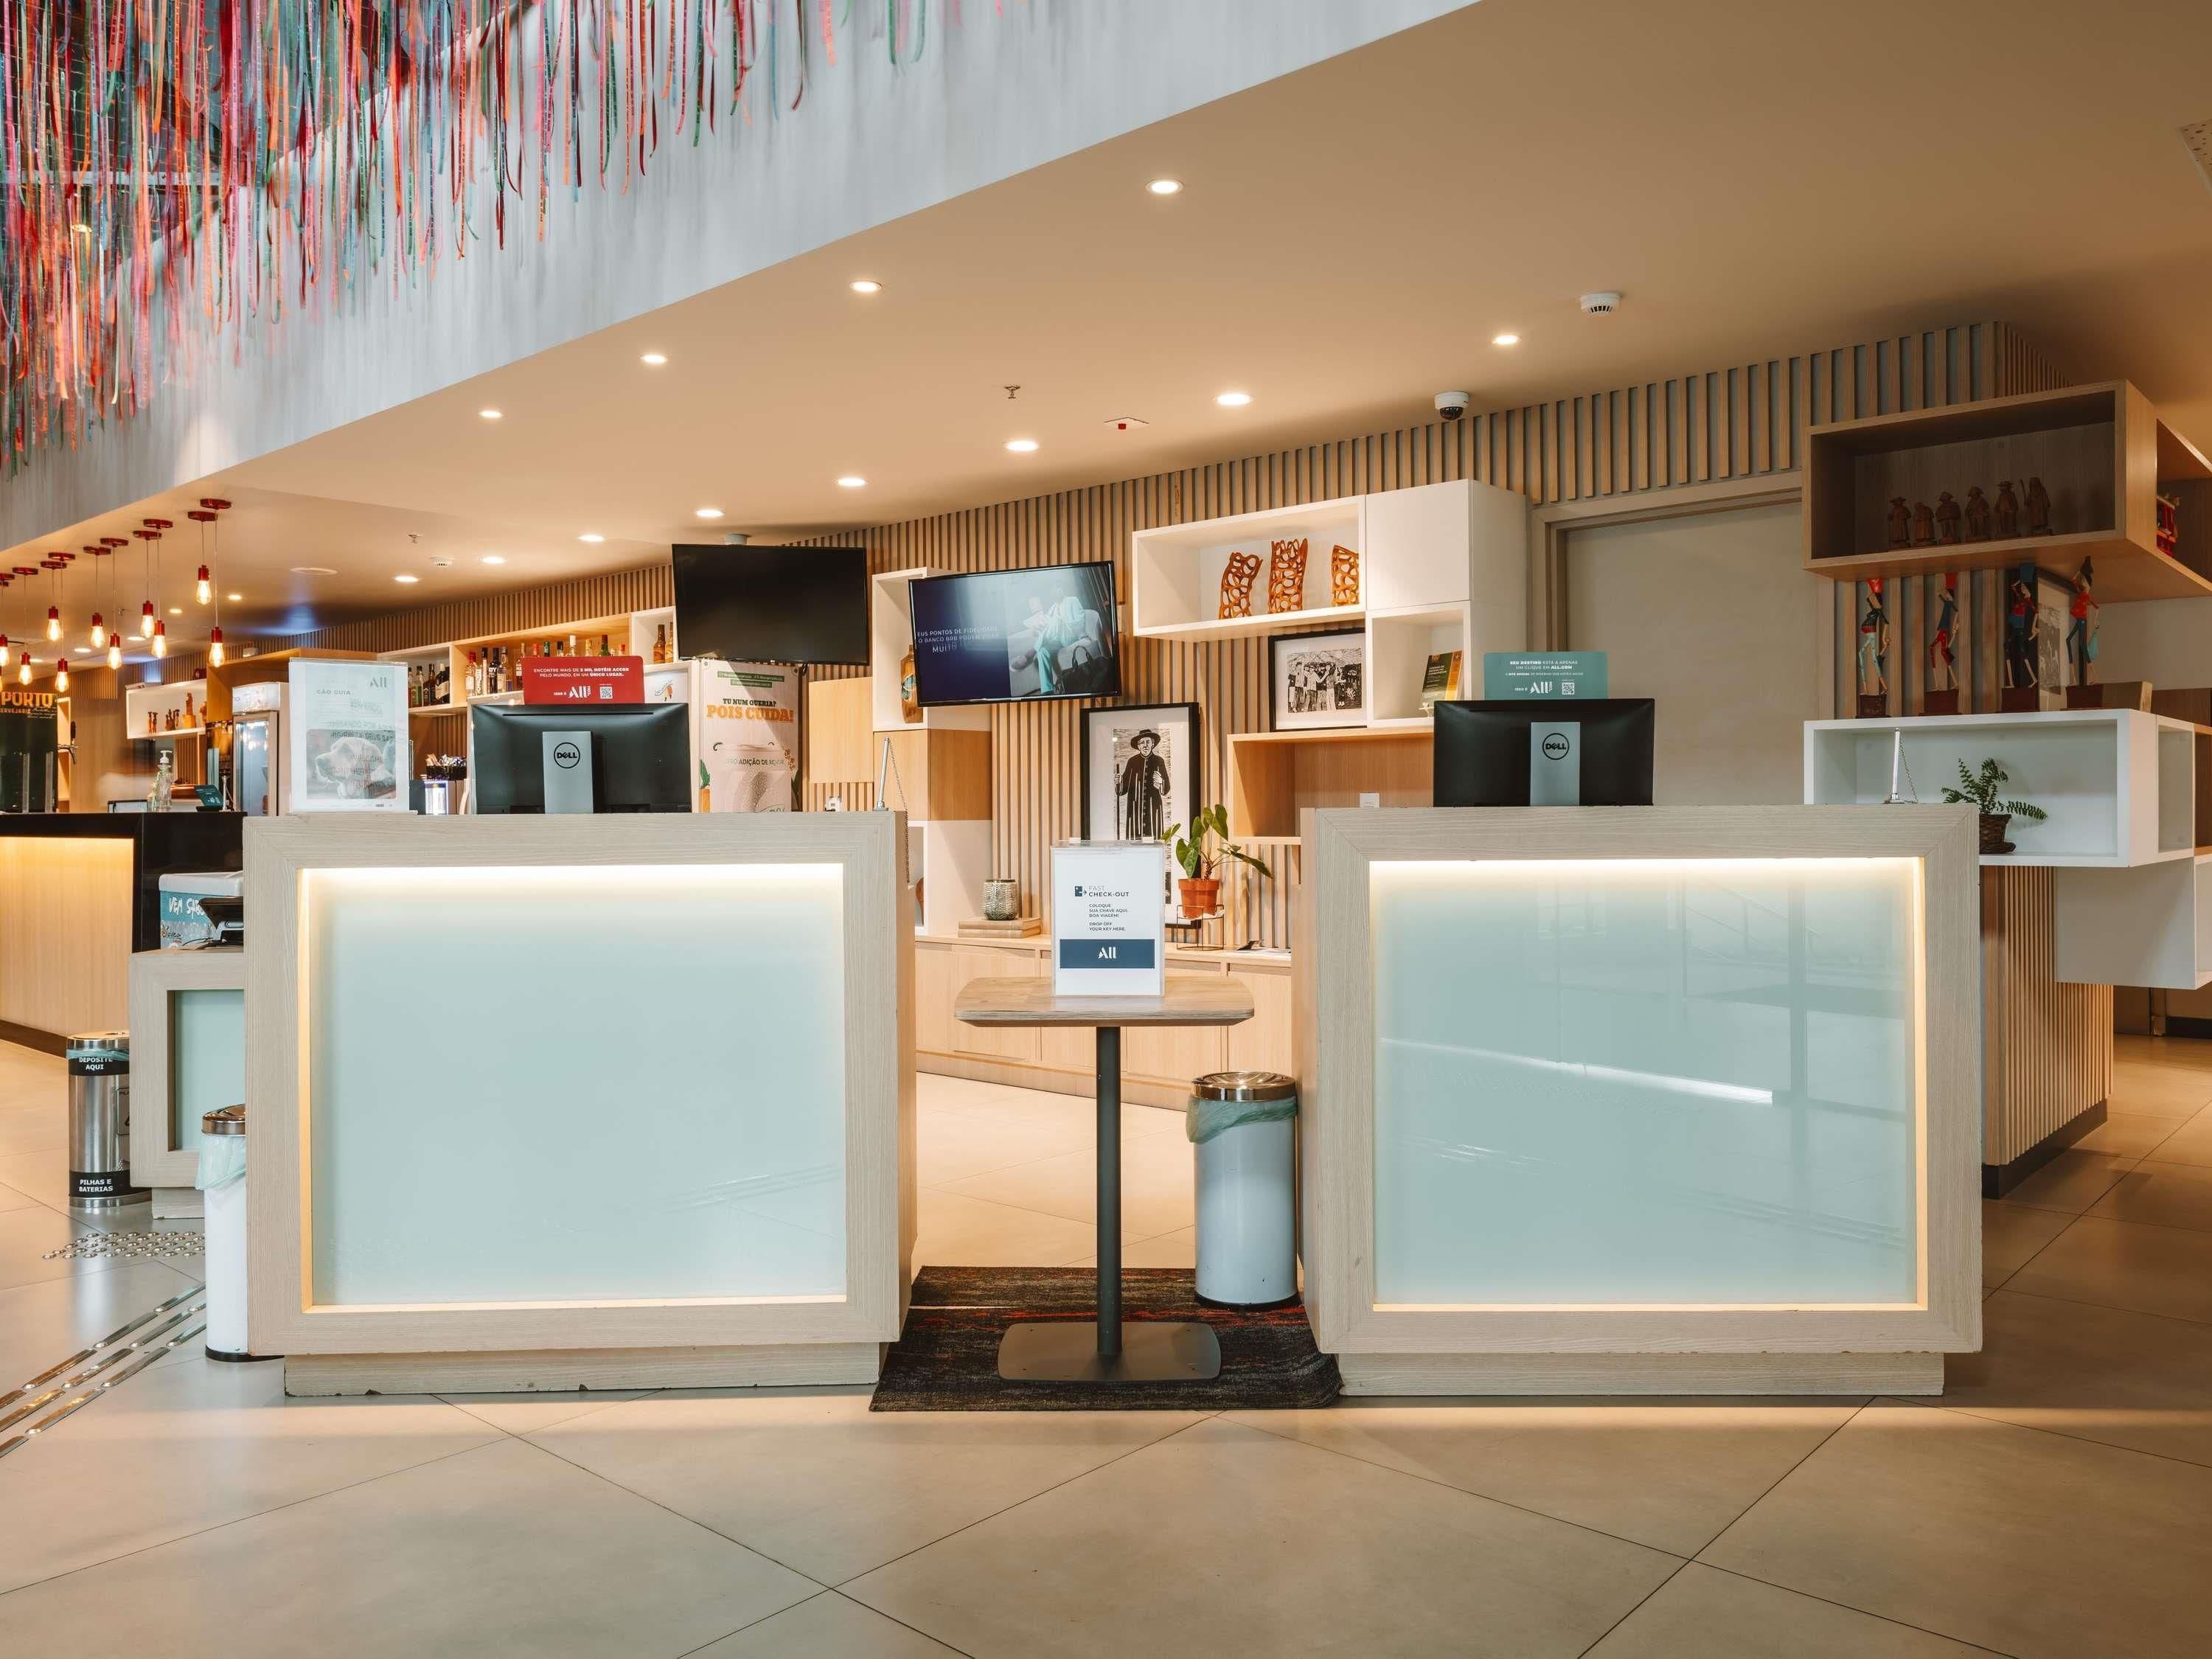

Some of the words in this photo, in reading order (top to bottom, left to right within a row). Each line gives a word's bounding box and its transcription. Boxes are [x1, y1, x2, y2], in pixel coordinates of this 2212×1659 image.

[1, 692, 53, 708] PORTO
[749, 700, 776, 708] QUERIA?
[706, 704, 743, 720] POIS
[745, 706, 794, 723] CUIDA!
[739, 757, 761, 766] ADIÇÃO
